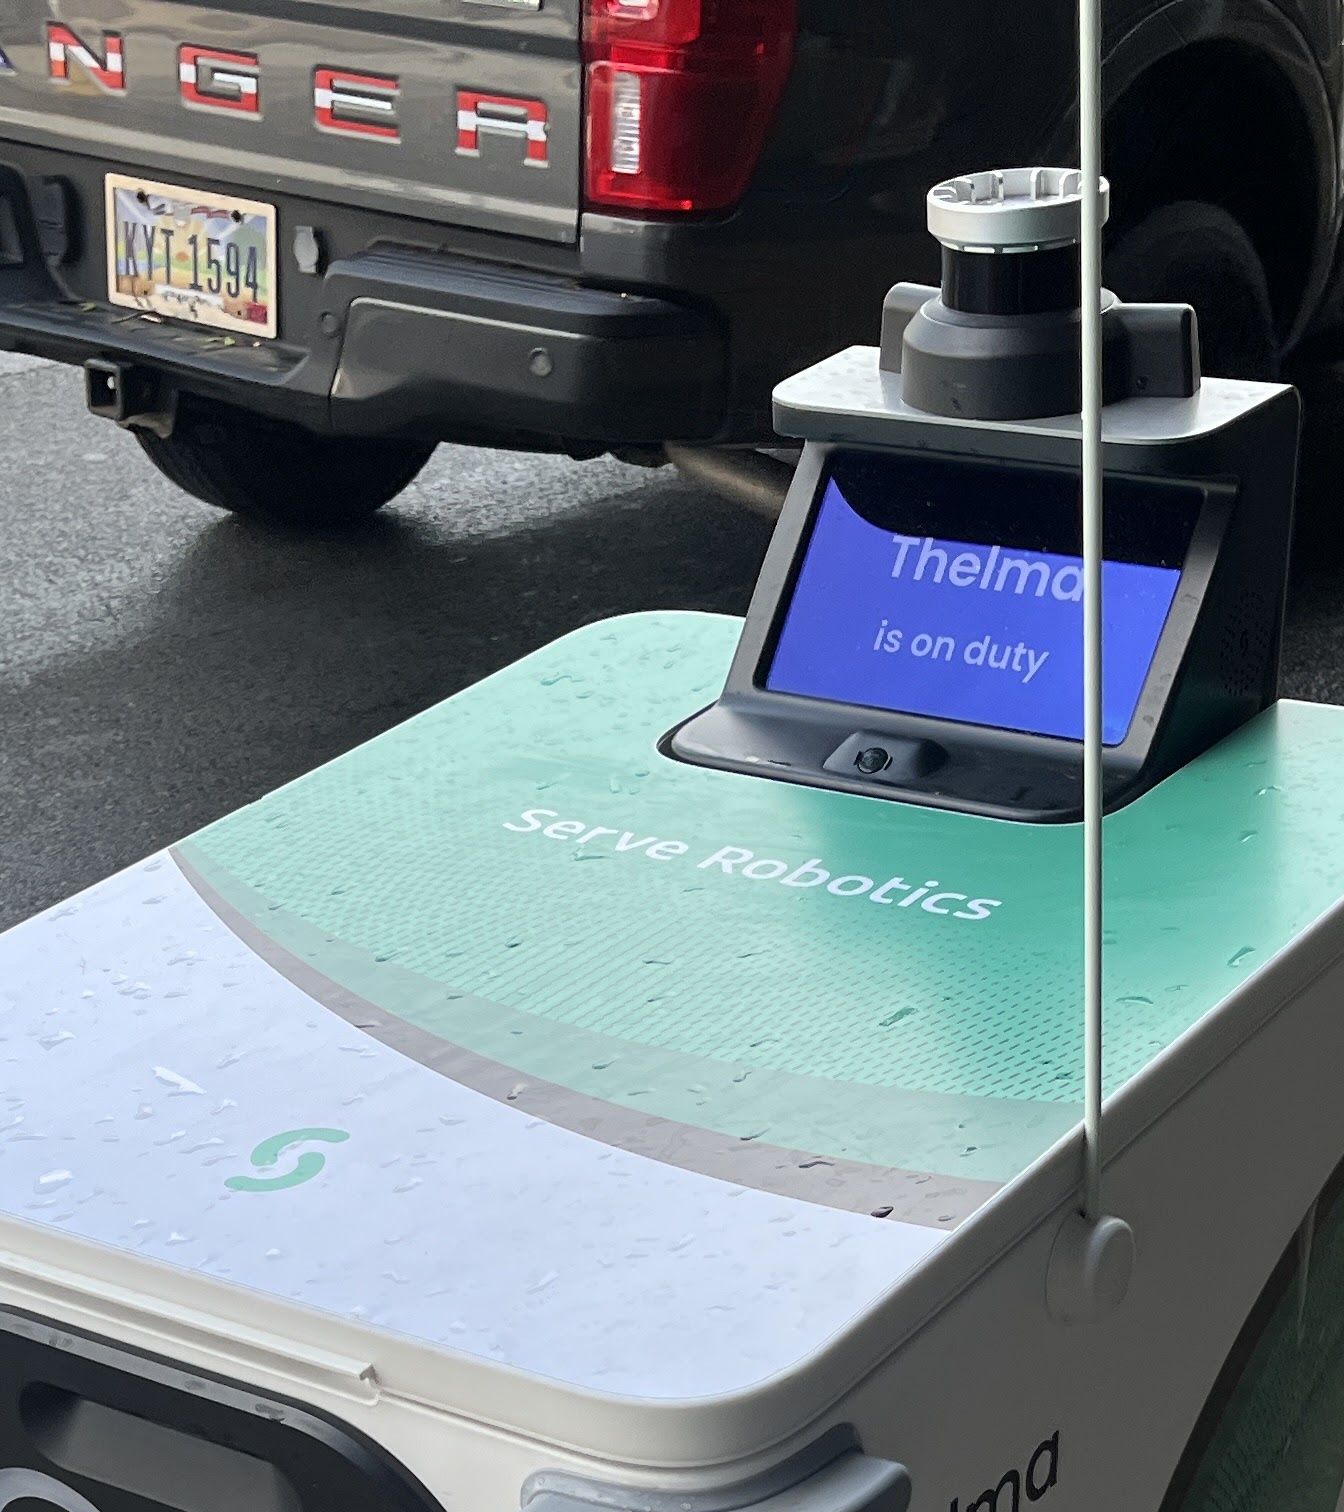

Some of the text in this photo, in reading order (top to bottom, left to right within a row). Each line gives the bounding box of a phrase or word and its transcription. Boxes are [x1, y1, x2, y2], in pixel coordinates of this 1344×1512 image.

[188, 234, 259, 302] 1594
[891, 533, 1084, 602] Thelma
[874, 619, 1049, 683] is on duty
[503, 808, 1002, 920] Serve Robotics
